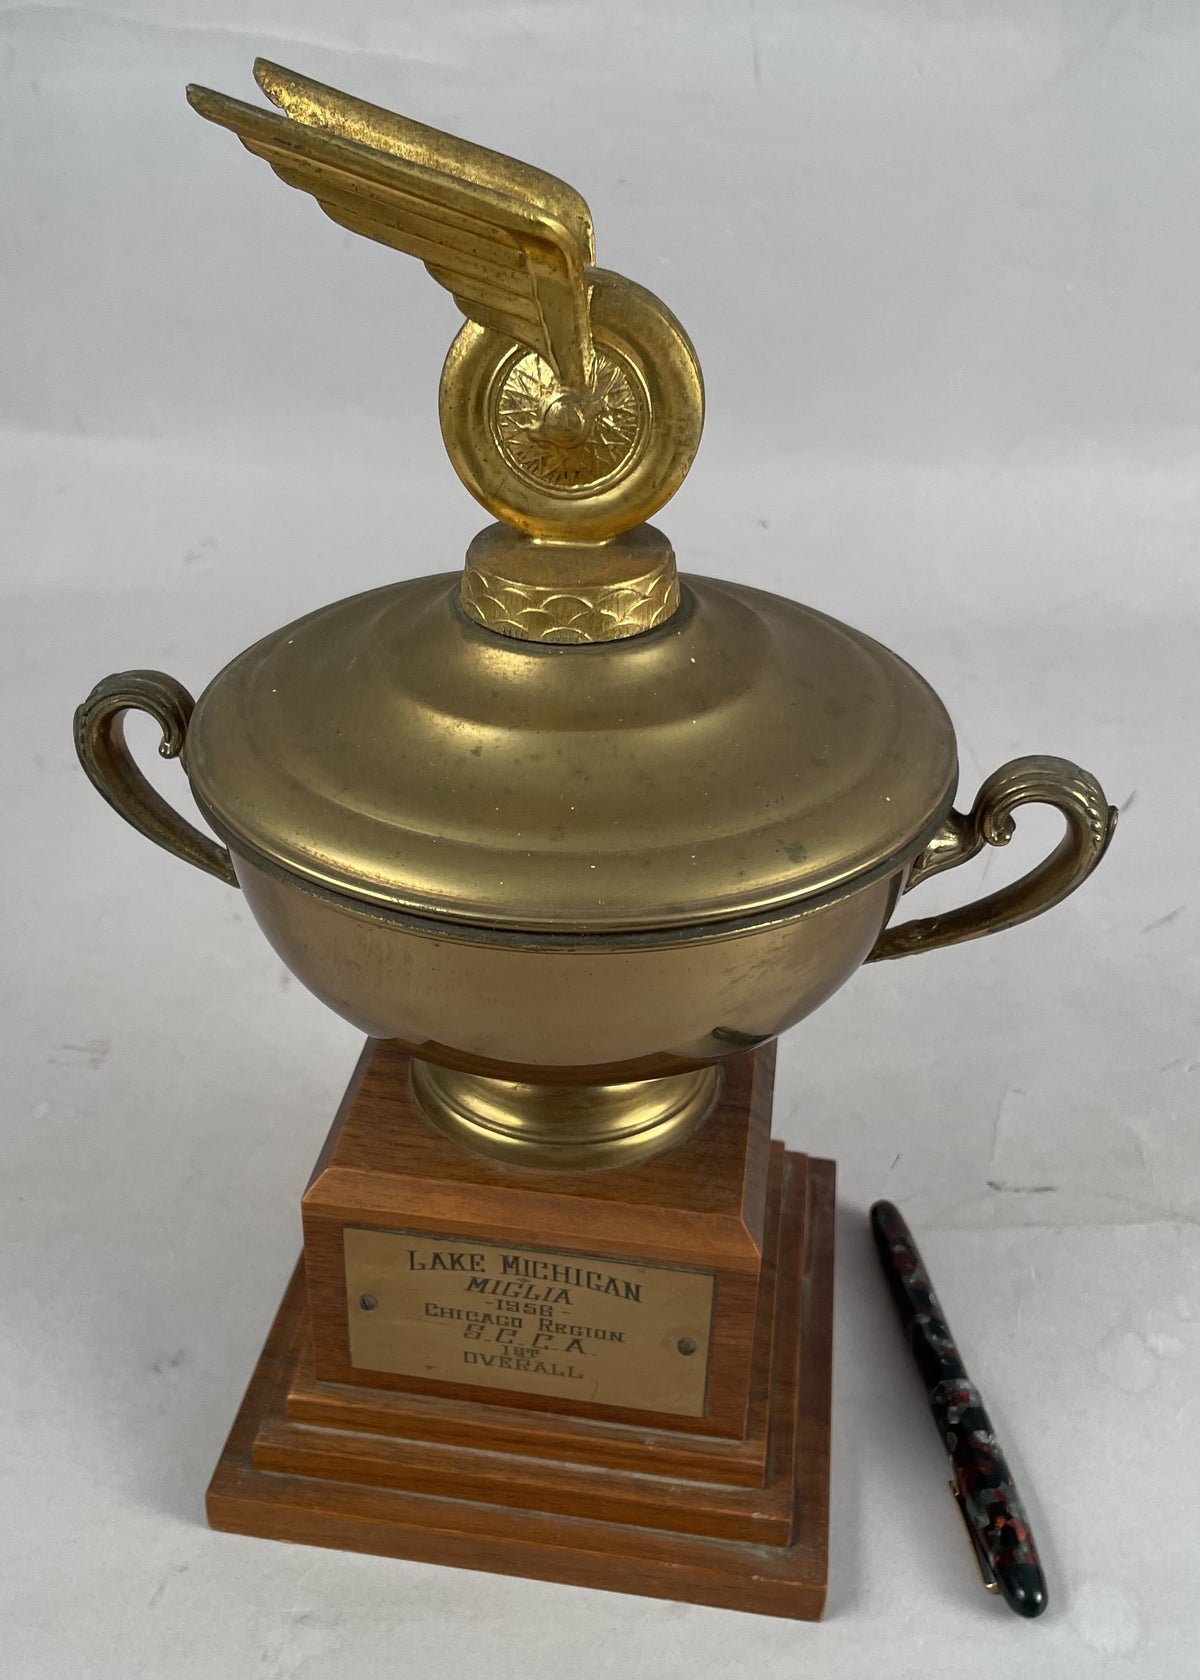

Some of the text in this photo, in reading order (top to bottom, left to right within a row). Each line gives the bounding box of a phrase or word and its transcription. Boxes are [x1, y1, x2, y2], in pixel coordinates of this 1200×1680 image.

[408, 1250, 643, 1303] LAKE MICHIGAN
[464, 1276, 573, 1305] MIGLIA
[463, 1351, 584, 1379] OVERALL
